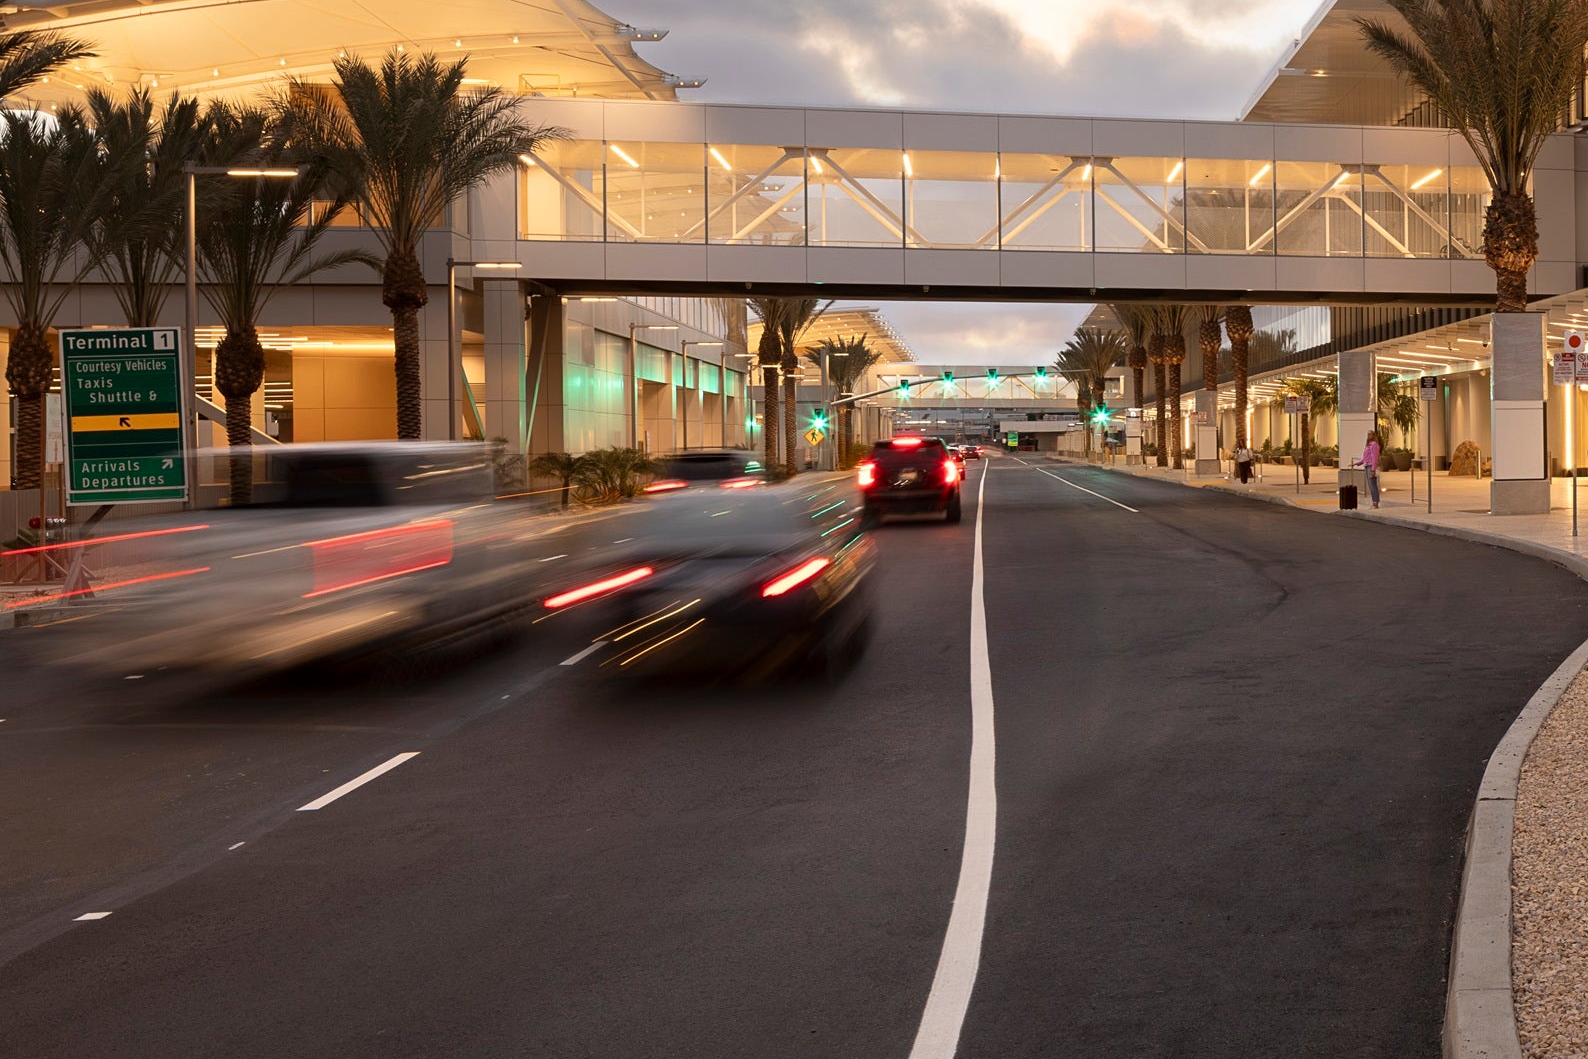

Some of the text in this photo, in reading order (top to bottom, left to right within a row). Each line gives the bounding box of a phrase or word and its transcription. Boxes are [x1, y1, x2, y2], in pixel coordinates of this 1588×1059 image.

[66, 333, 168, 350] Terminal 1
[76, 359, 167, 374] Courtesy Vehicles
[77, 377, 113, 389] Taxis
[89, 390, 157, 403] Shuttle &
[82, 460, 140, 473] Arrivals
[82, 475, 164, 489] Departures
